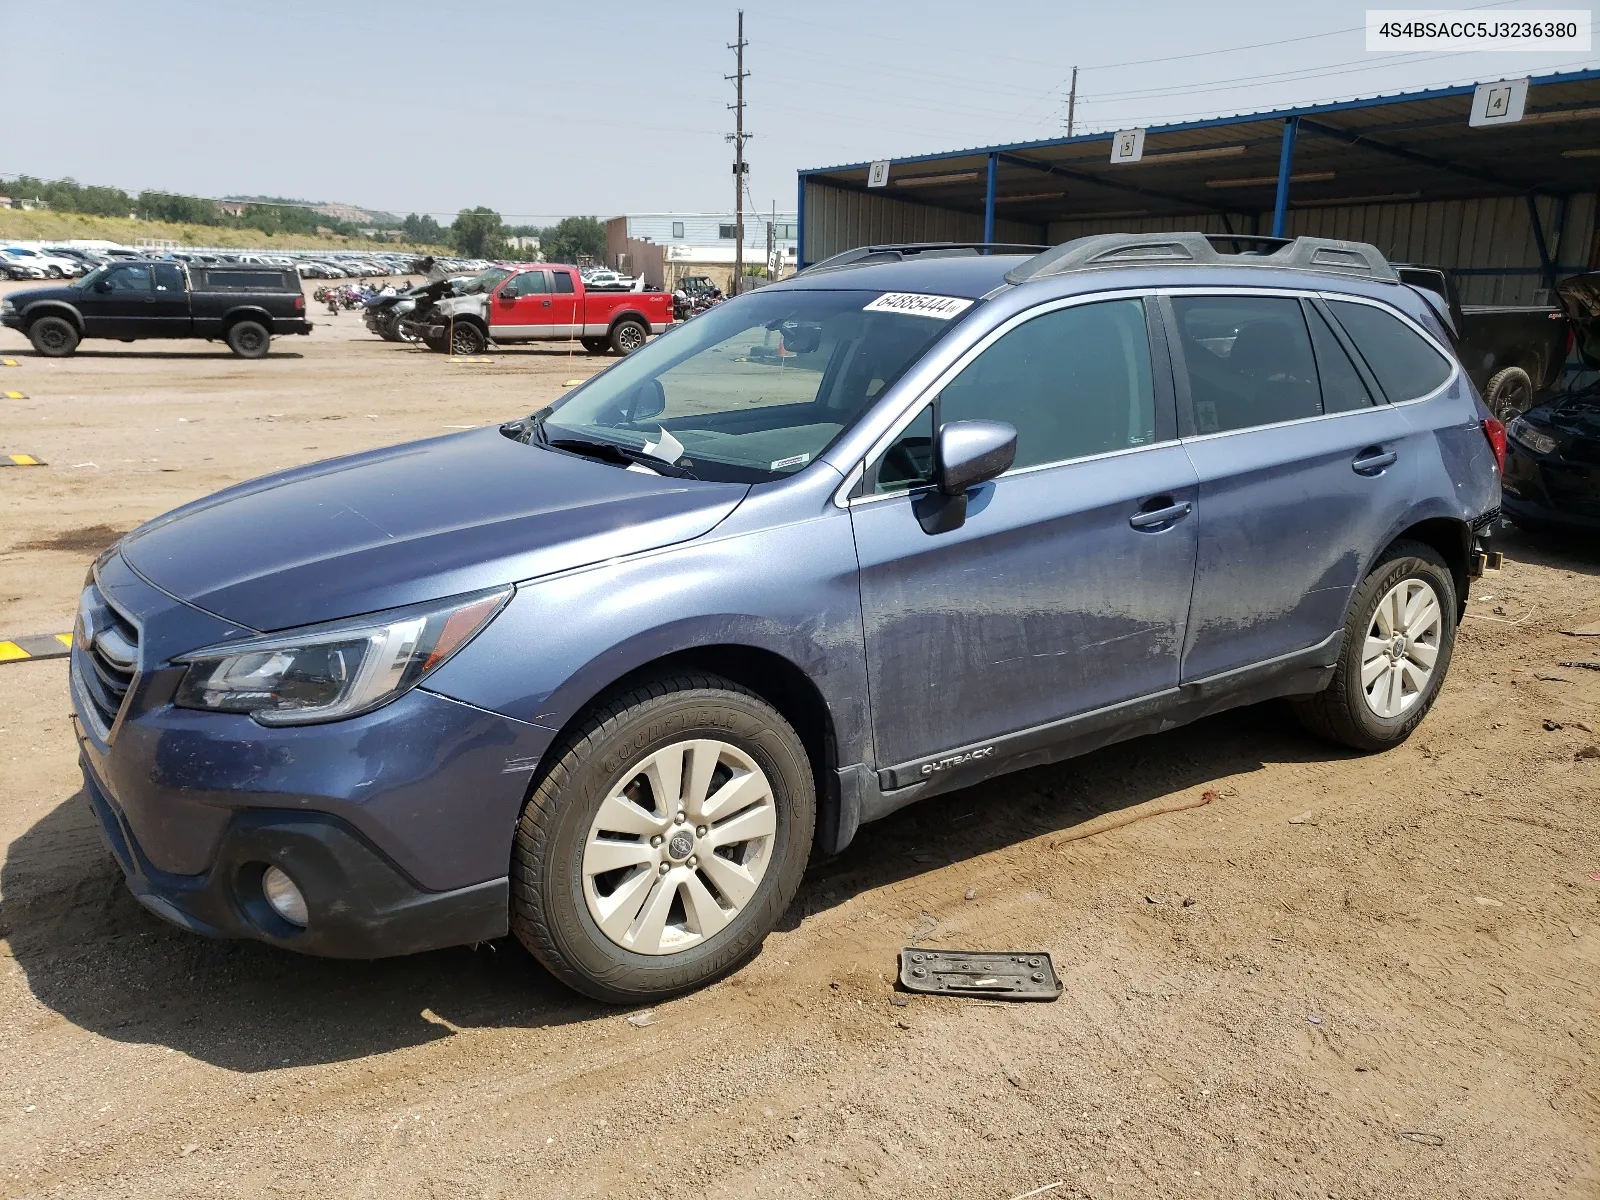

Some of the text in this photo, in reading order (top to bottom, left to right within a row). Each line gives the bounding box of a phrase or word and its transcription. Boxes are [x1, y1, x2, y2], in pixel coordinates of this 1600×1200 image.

[1493, 98, 1502, 109] 4
[1124, 142, 1130, 151] 5
[921, 747, 993, 775] OUTBACK
